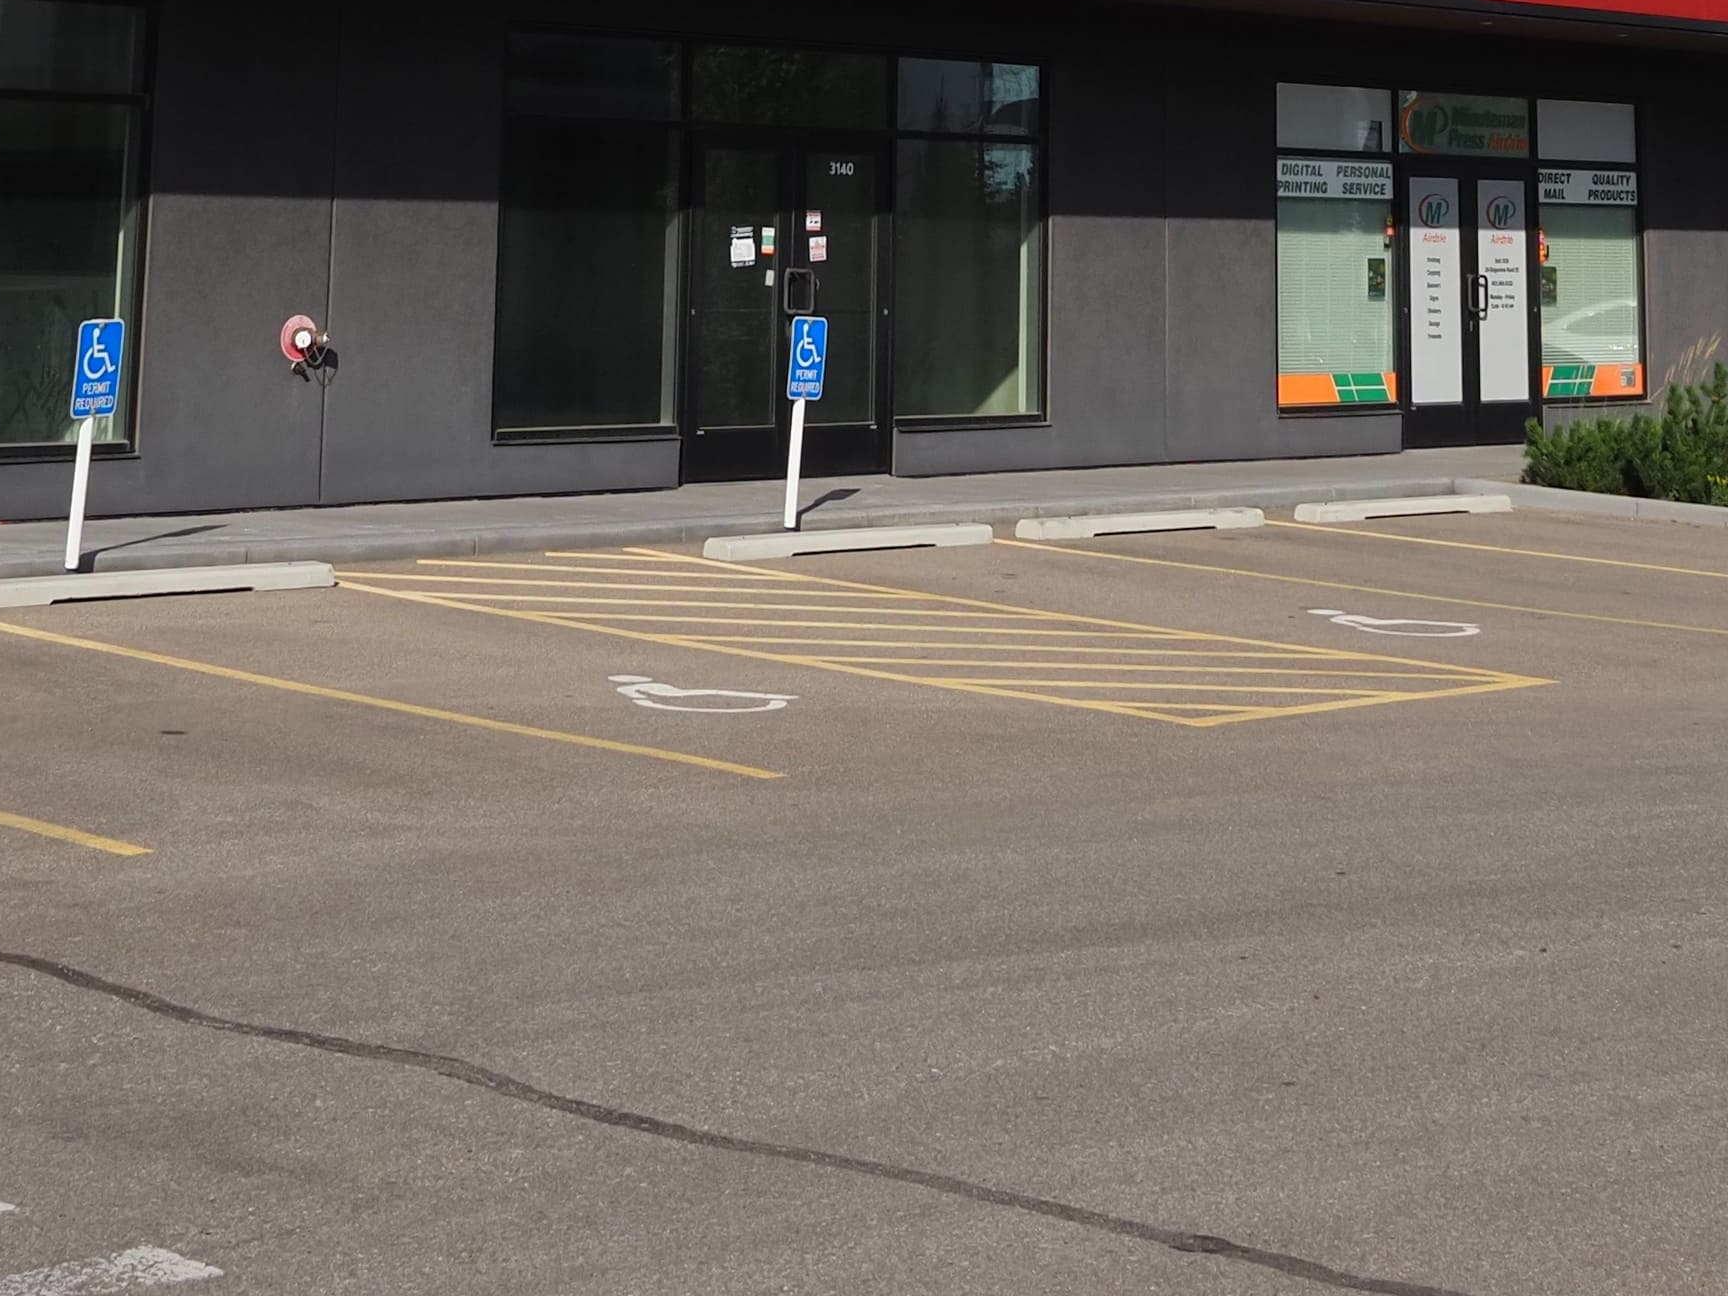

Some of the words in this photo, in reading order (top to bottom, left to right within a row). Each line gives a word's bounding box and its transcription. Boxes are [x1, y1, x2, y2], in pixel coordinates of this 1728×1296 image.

[829, 161, 854, 176] 3140
[1281, 163, 1323, 177] DIGITAL
[1336, 165, 1391, 179] PERSONAL
[1538, 172, 1572, 185] DIRECT
[1592, 174, 1631, 186] QUALITY
[1278, 180, 1328, 194] PRINTING
[1342, 182, 1386, 196] SERVICE
[1544, 188, 1566, 200] MAIL
[1588, 189, 1636, 202] PRODUCTS
[796, 369, 818, 381] PERMIT
[82, 381, 112, 395] PERMIT
[75, 395, 114, 410] REQUIRED
